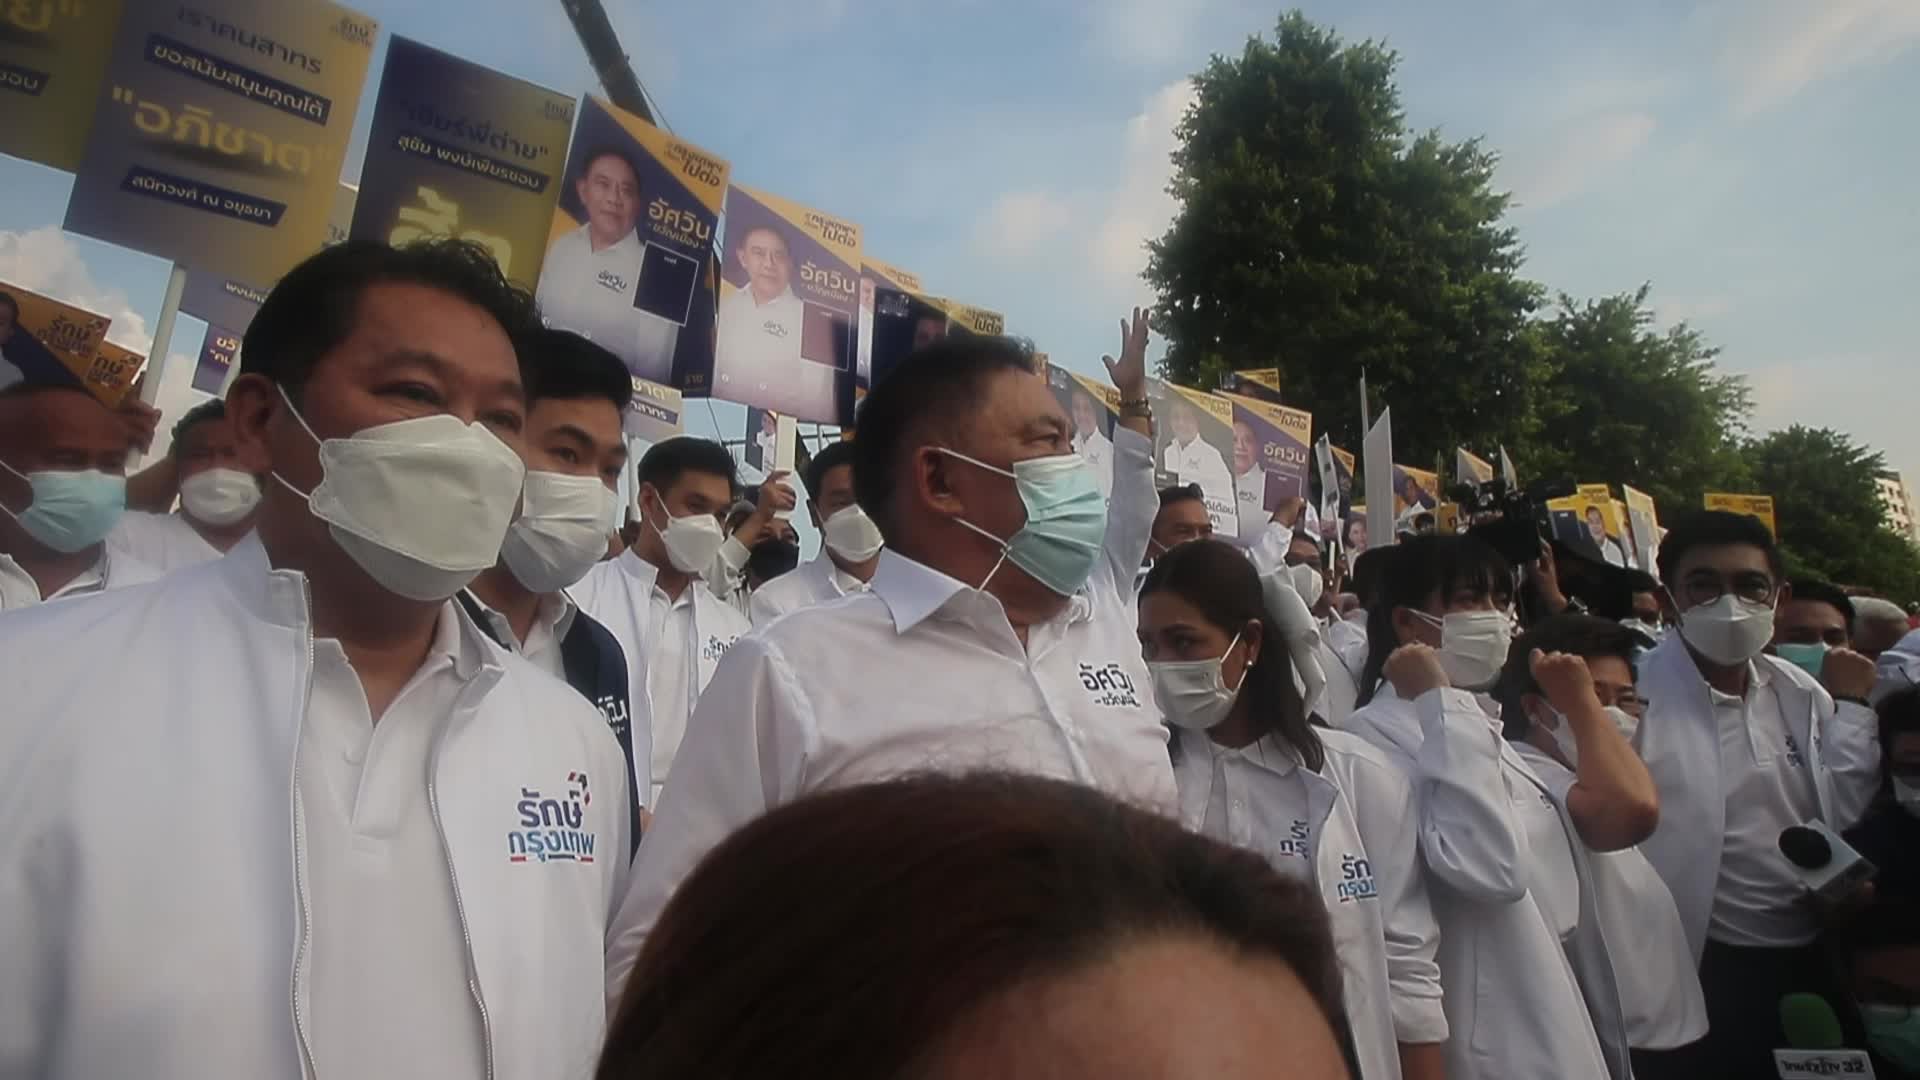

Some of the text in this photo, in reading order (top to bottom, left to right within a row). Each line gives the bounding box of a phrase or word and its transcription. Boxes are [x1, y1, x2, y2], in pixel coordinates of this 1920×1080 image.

[648, 196, 712, 242] อัศวิน
[800, 259, 856, 295] อัศวิน
[974, 316, 1002, 334] ไปต่อ
[1280, 413, 1307, 431] ไปต่อ
[1263, 440, 1306, 465] อัศวิน
[508, 830, 595, 862] กรุงเทพ
